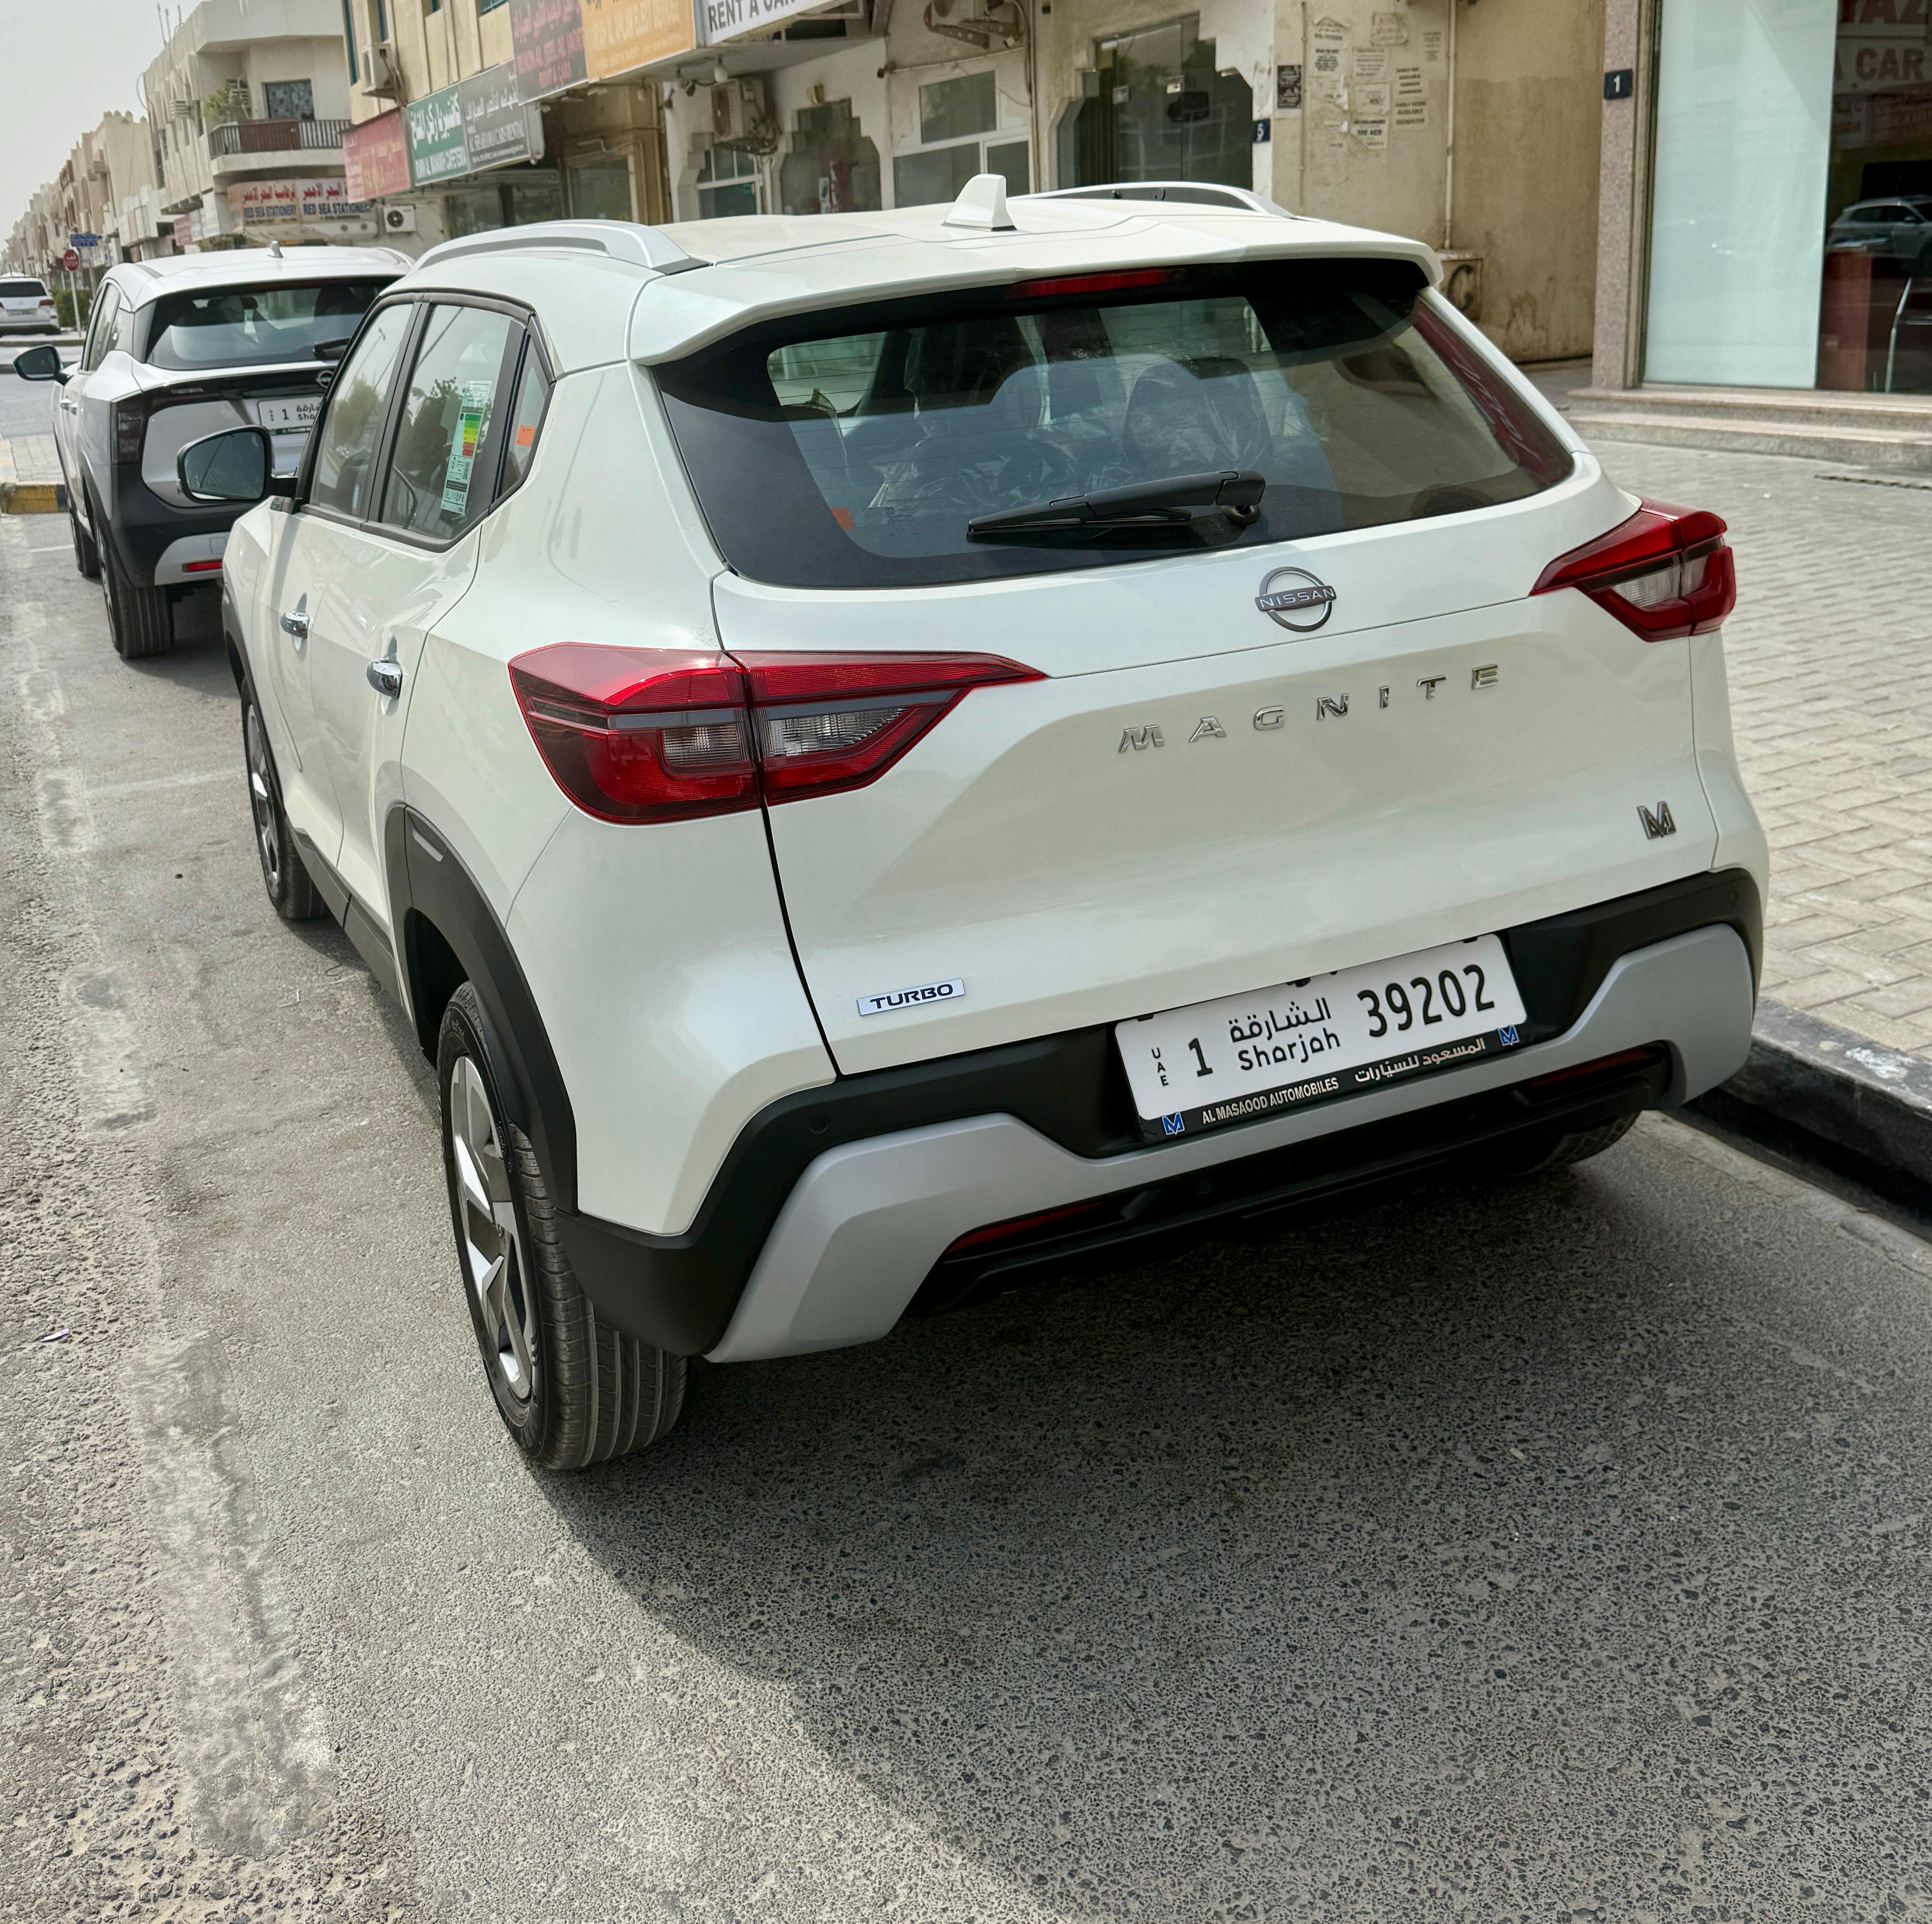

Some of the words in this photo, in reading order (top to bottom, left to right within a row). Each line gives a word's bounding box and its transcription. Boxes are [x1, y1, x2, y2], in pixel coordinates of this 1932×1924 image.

[708, 0, 742, 33] RENT
[750, 0, 759, 18] A
[1855, 47, 1924, 81] CAR
[1613, 74, 1621, 93] 1
[1257, 123, 1264, 142] 5
[244, 207, 254, 218] RED
[255, 207, 265, 218] SEA
[303, 203, 316, 215] RED
[318, 203, 332, 214] SEA
[282, 409, 289, 420] 1
[1259, 588, 1335, 608] NISSAN
[1118, 664, 1499, 753] MAGNITE
[870, 984, 953, 1009] TURBO
[1357, 964, 1495, 1038] 39202
[1228, 998, 1331, 1043] الشارقة
[1188, 1038, 1213, 1077] 1
[1238, 1027, 1341, 1071] Sharjah
[1422, 1038, 1486, 1066] المسعود
[1203, 1109, 1216, 1124] AL
[1216, 1095, 1268, 1120] MASAOOD
[1269, 1076, 1340, 1107] AUTOMOBILES
